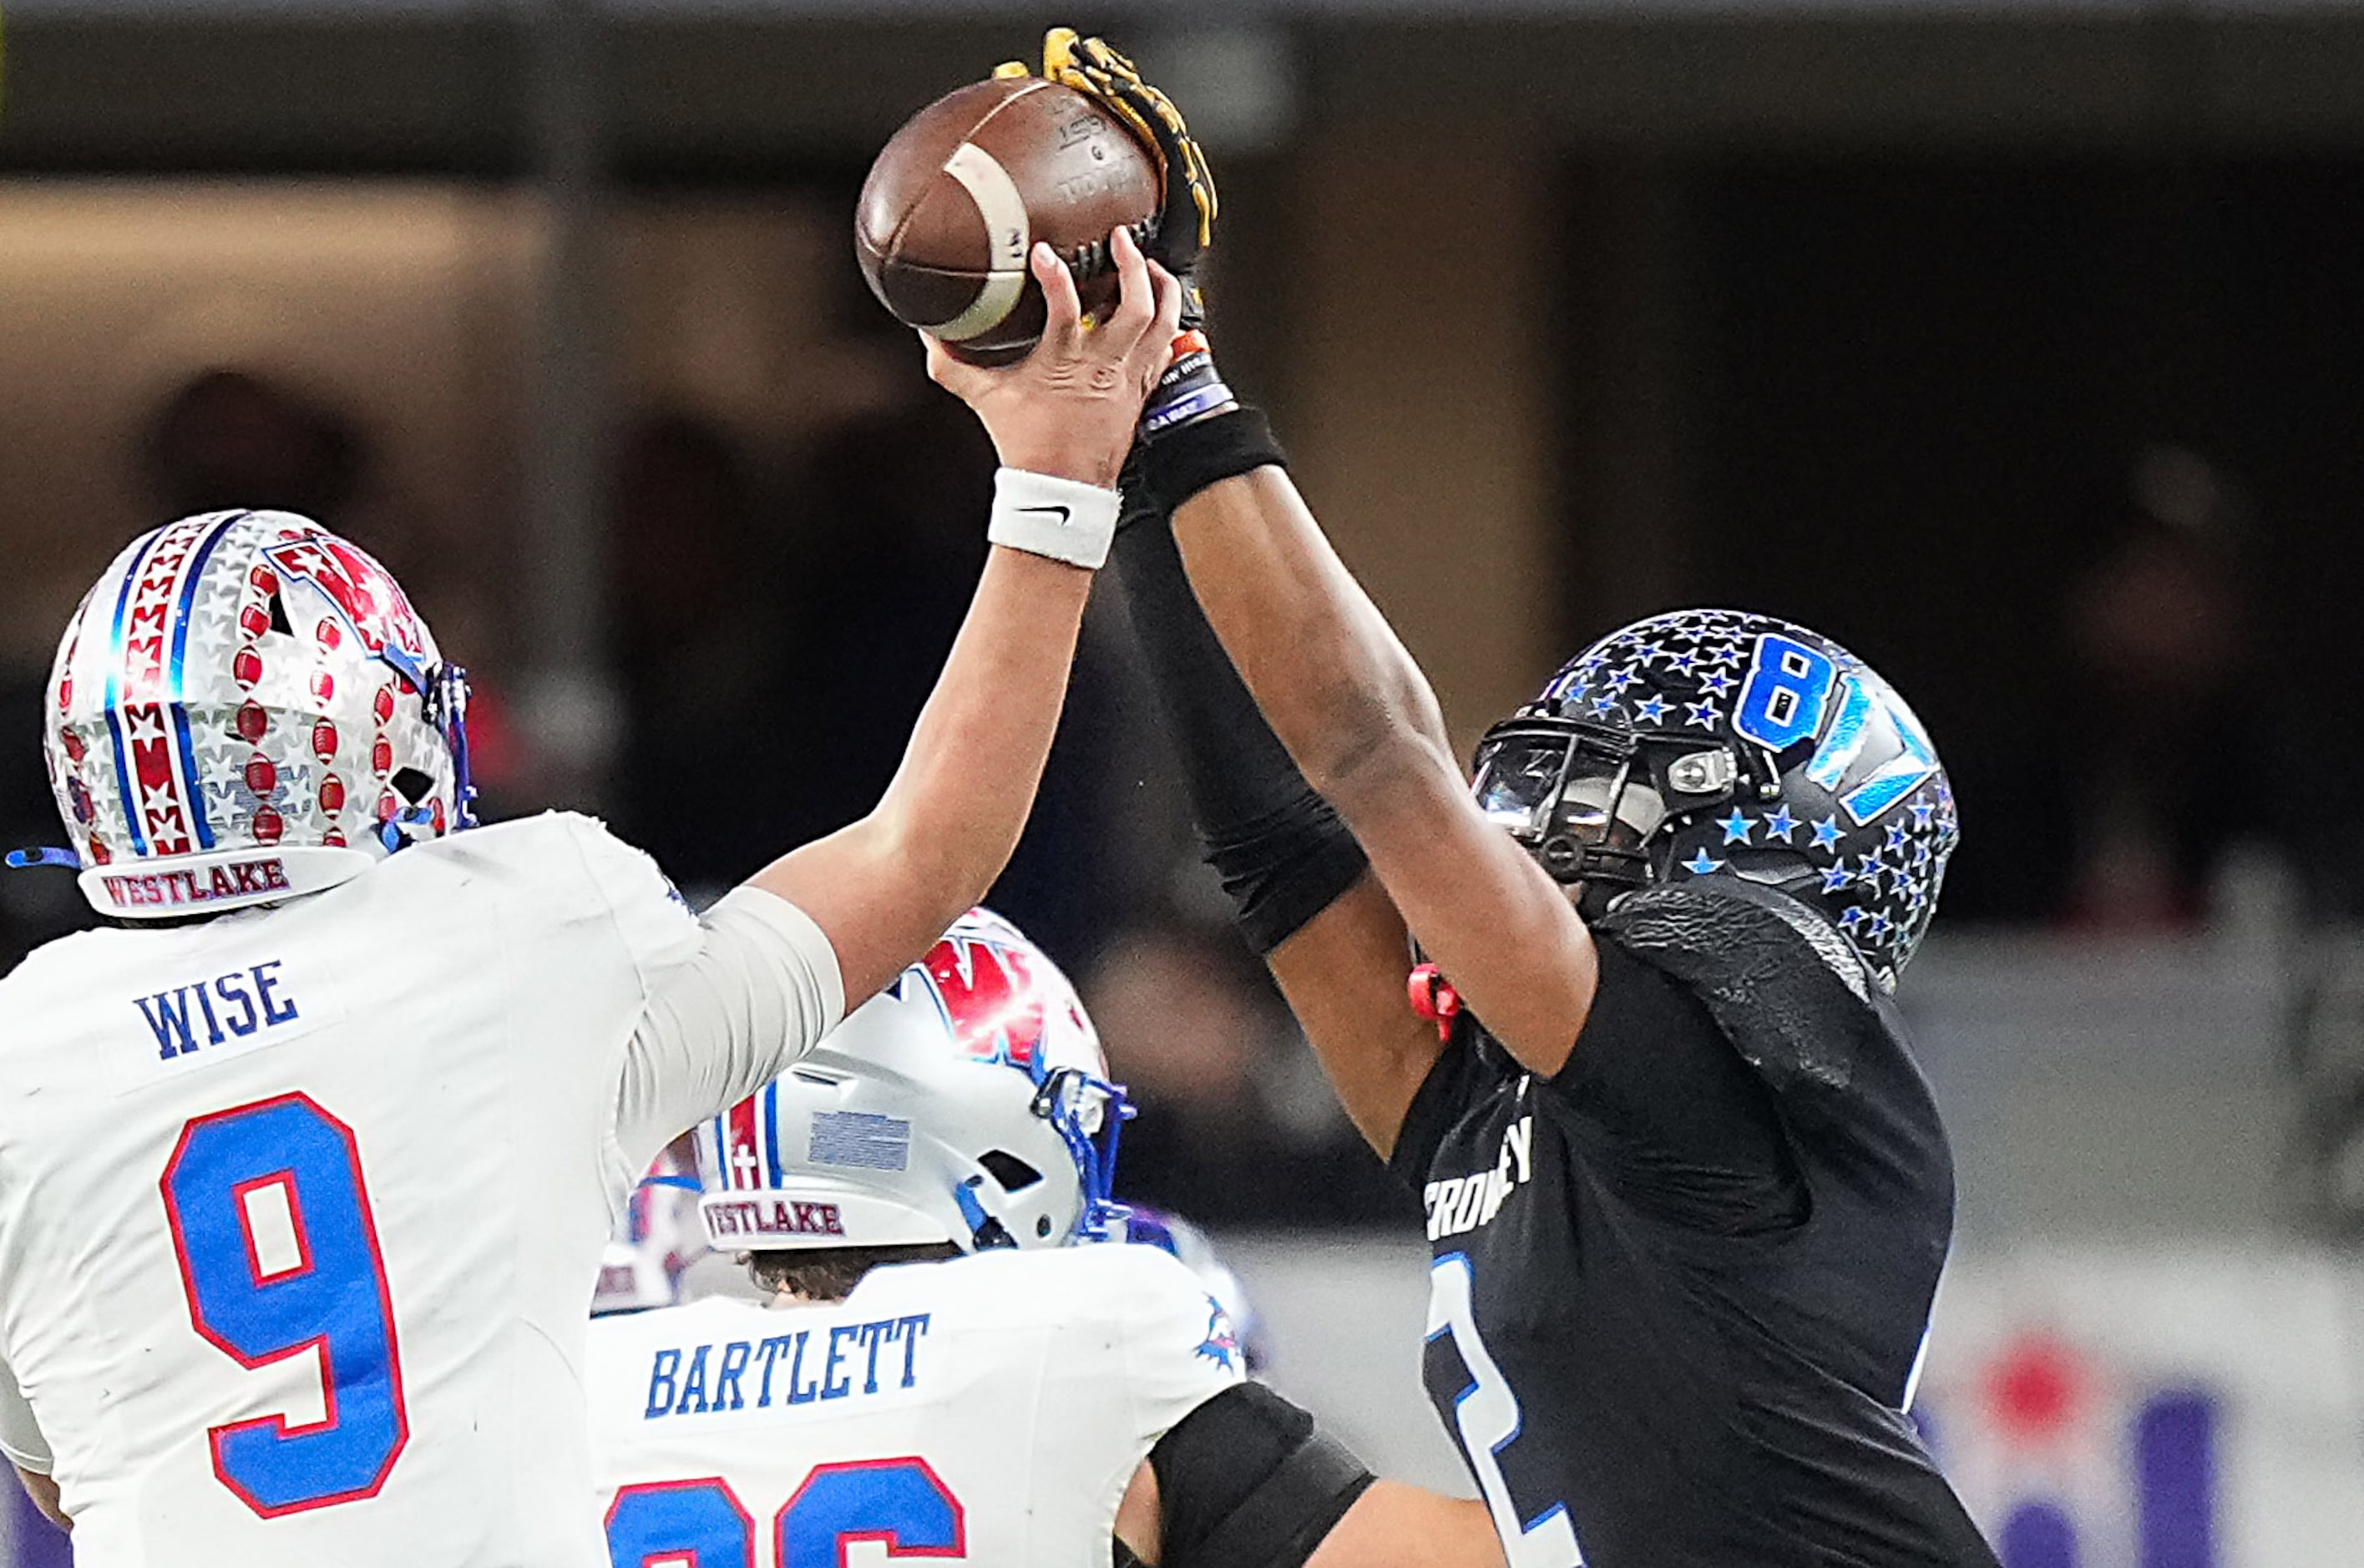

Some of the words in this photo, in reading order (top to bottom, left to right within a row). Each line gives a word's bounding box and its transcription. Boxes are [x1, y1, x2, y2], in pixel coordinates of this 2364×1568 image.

[101, 857, 291, 908] WESTLAKE
[132, 959, 300, 1060] WISE
[159, 1090, 410, 1520] 9
[644, 1313, 931, 1419] BARTLETT
